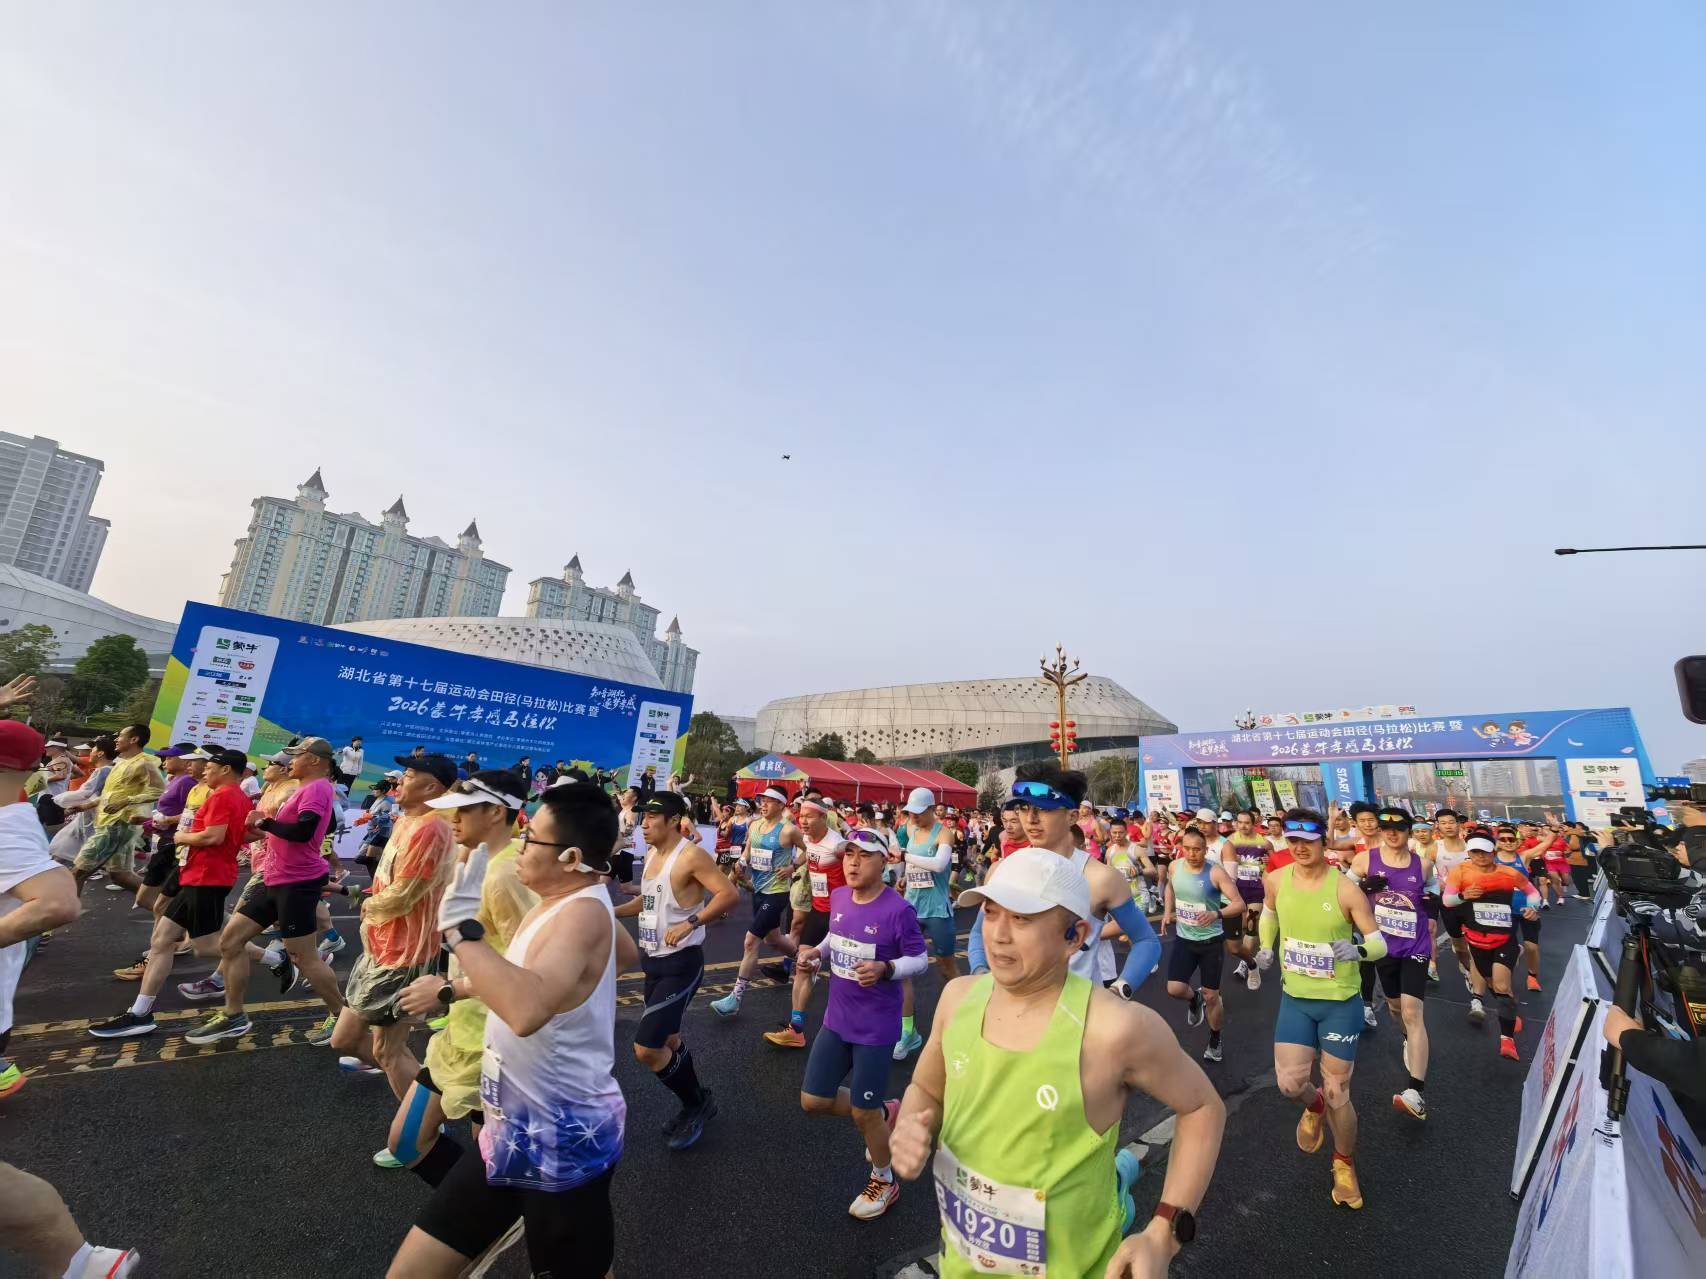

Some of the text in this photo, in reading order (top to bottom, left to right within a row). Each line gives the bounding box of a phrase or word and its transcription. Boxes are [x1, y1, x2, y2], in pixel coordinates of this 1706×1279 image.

[232, 641, 258, 653] 蒙牛
[1336, 768, 1349, 793] START
[1387, 918, 1409, 929] 1645
[1285, 951, 1325, 967] A 0055
[970, 1176, 998, 1200] 蒙牛
[954, 1200, 1016, 1249] 1920
